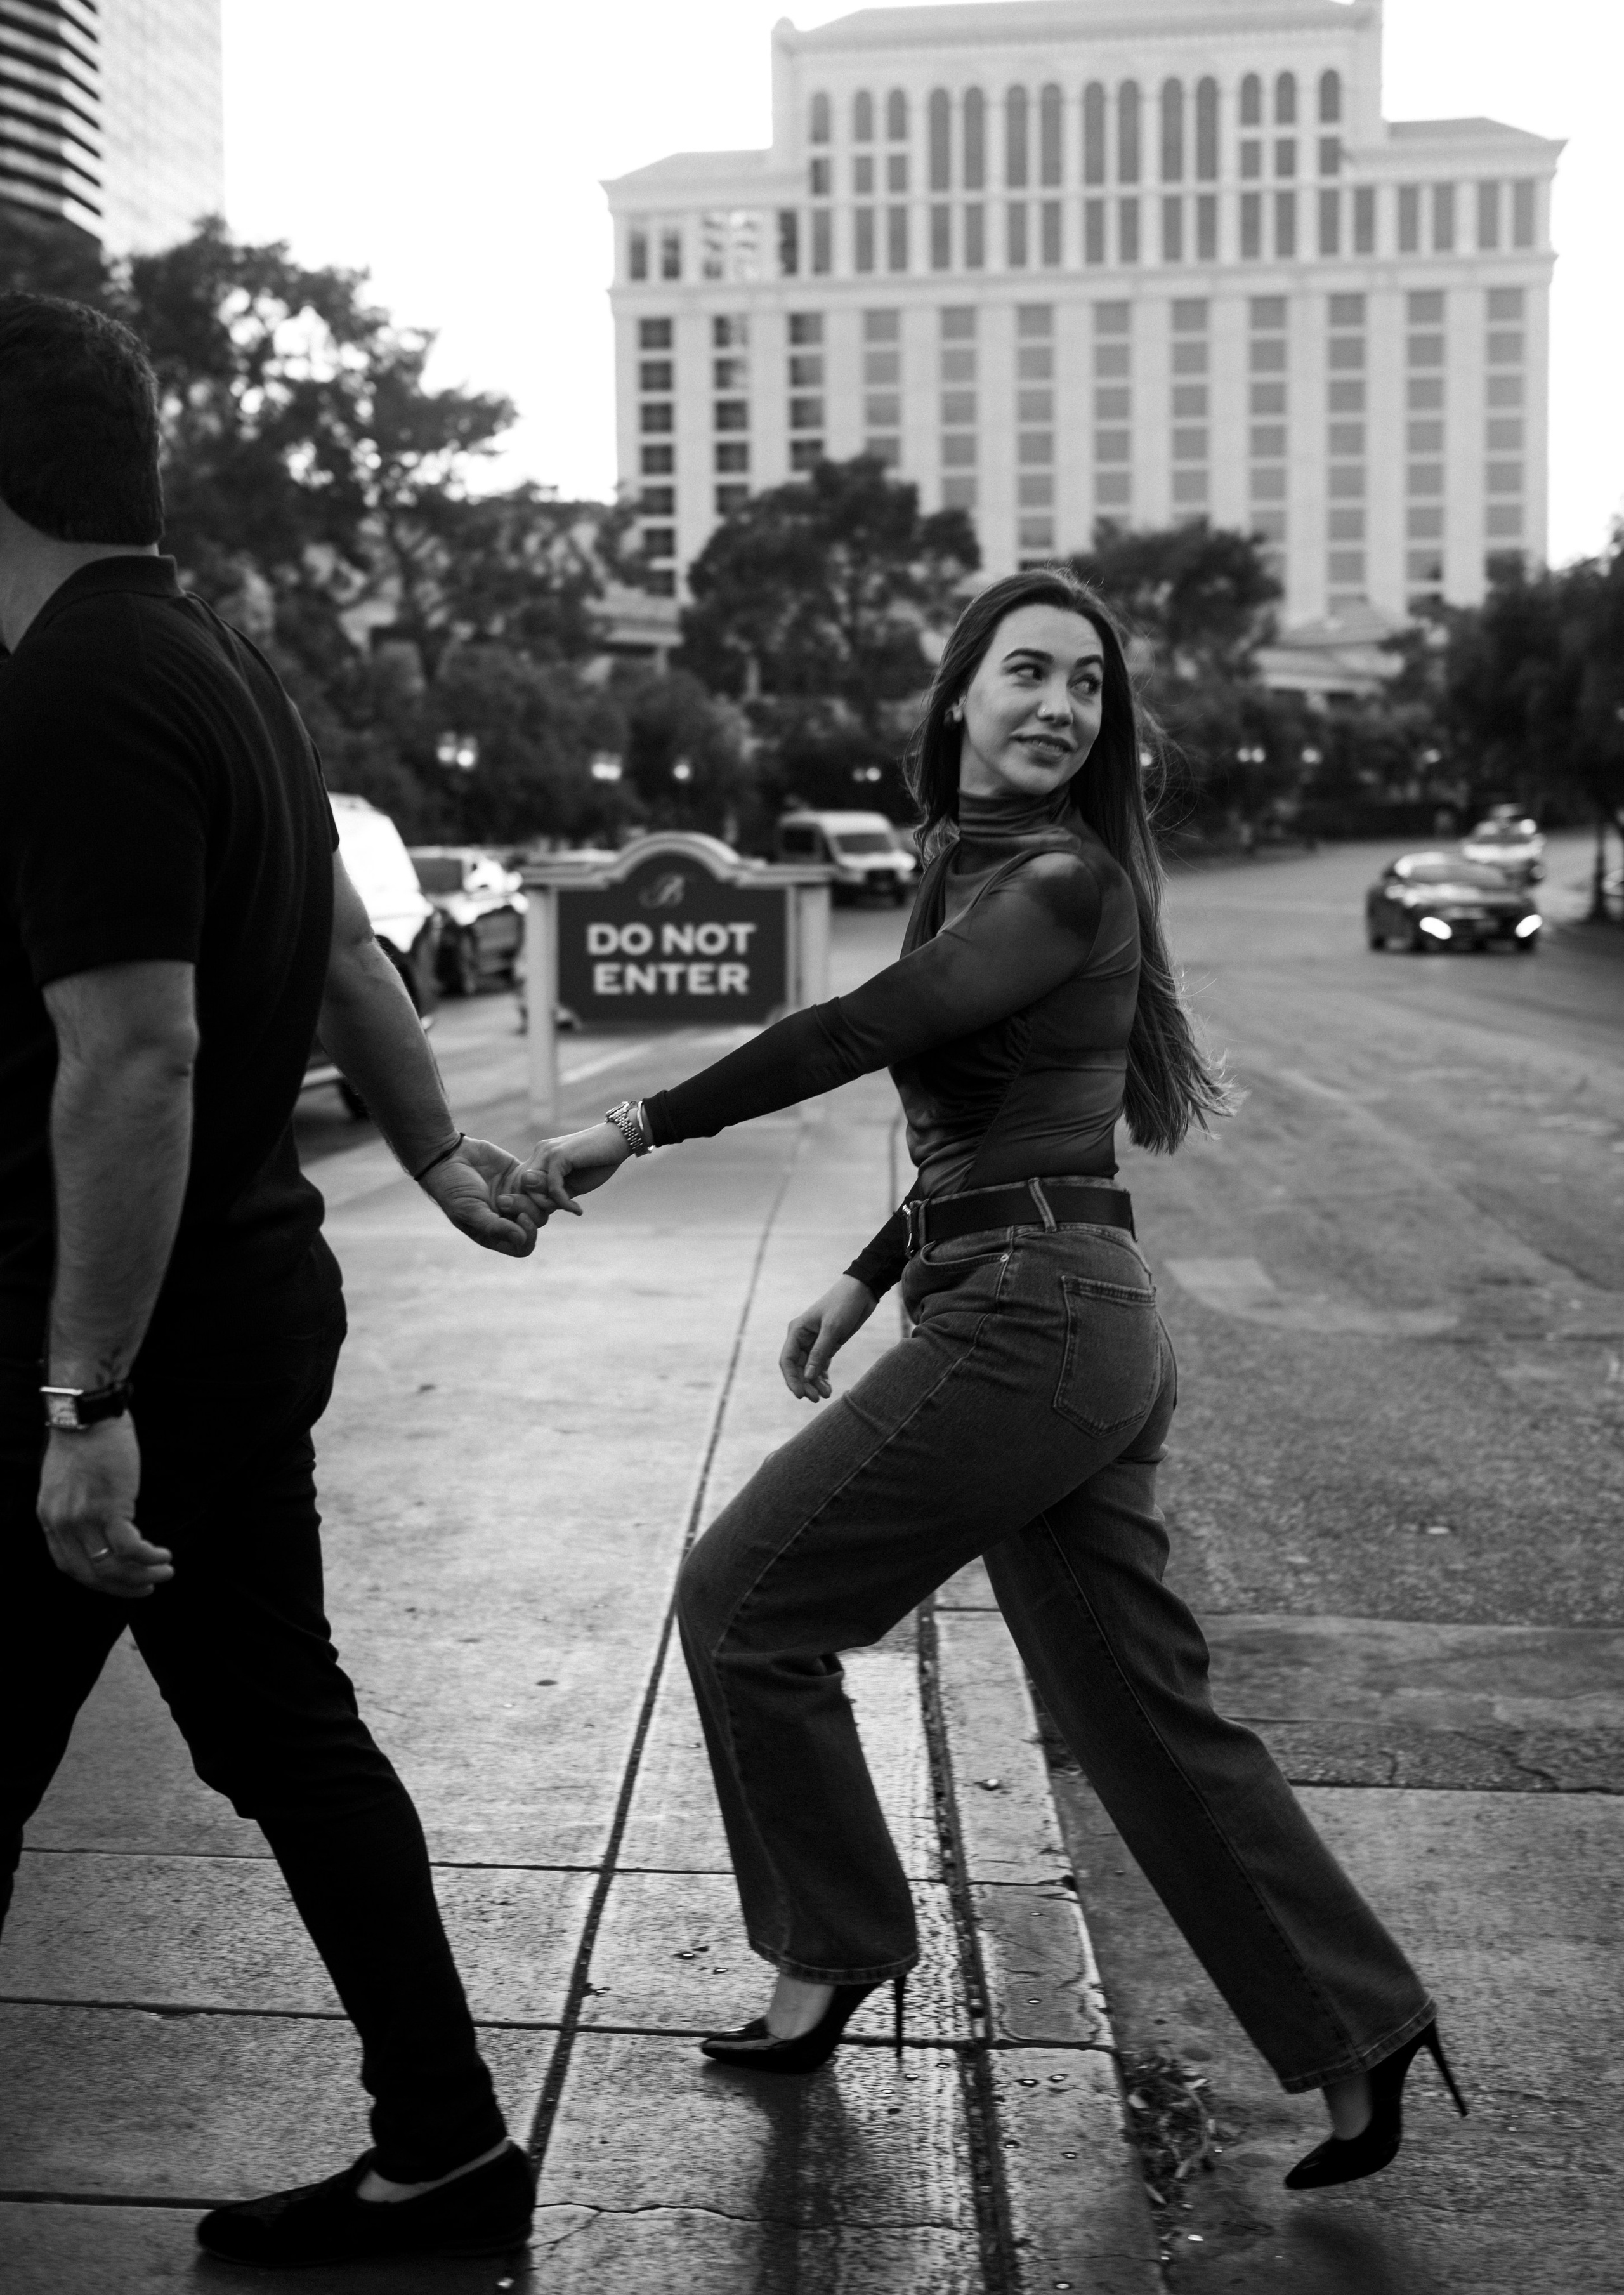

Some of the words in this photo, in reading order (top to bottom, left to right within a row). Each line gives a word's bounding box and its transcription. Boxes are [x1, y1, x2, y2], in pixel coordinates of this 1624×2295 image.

[586, 922, 654, 956] DO
[661, 922, 757, 956] NOT
[593, 962, 750, 995] ENTER
